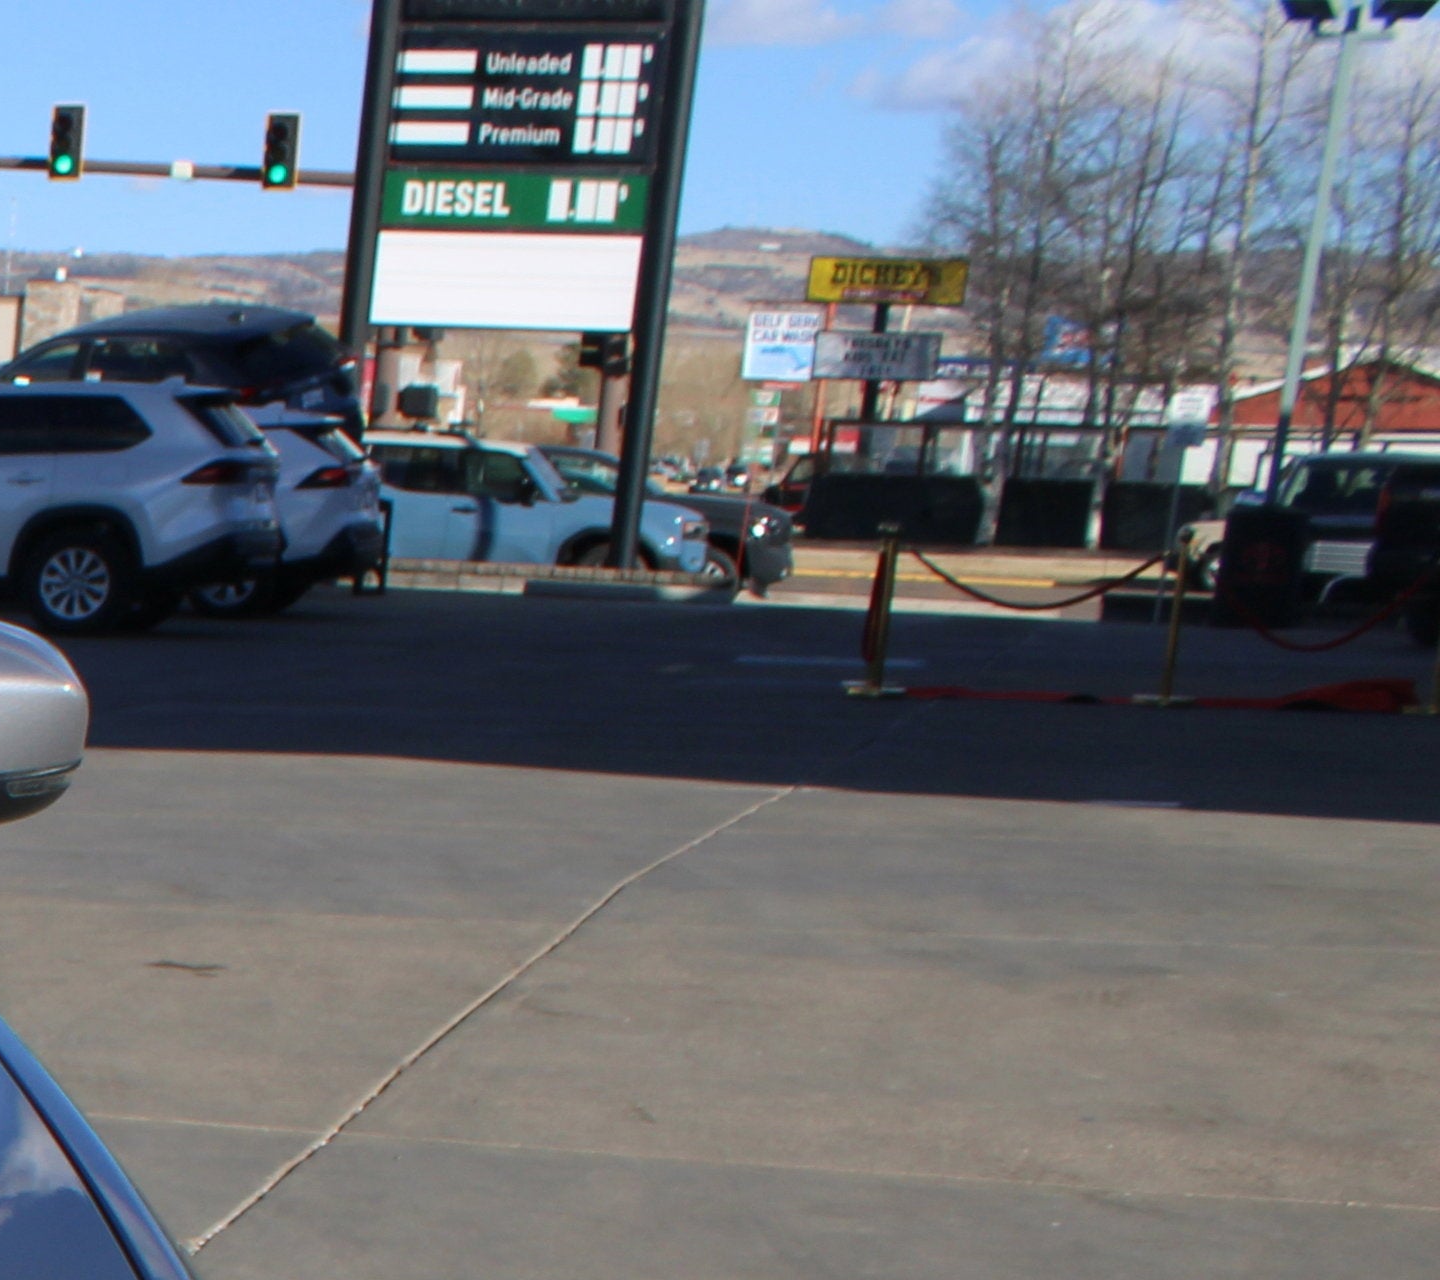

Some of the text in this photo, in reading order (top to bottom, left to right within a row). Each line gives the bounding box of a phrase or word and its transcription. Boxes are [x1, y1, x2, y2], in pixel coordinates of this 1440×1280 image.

[485, 51, 572, 75] Unleaded
[482, 86, 573, 110] Mid-Grade
[478, 122, 561, 146] Premium
[401, 179, 511, 217] DIESEL
